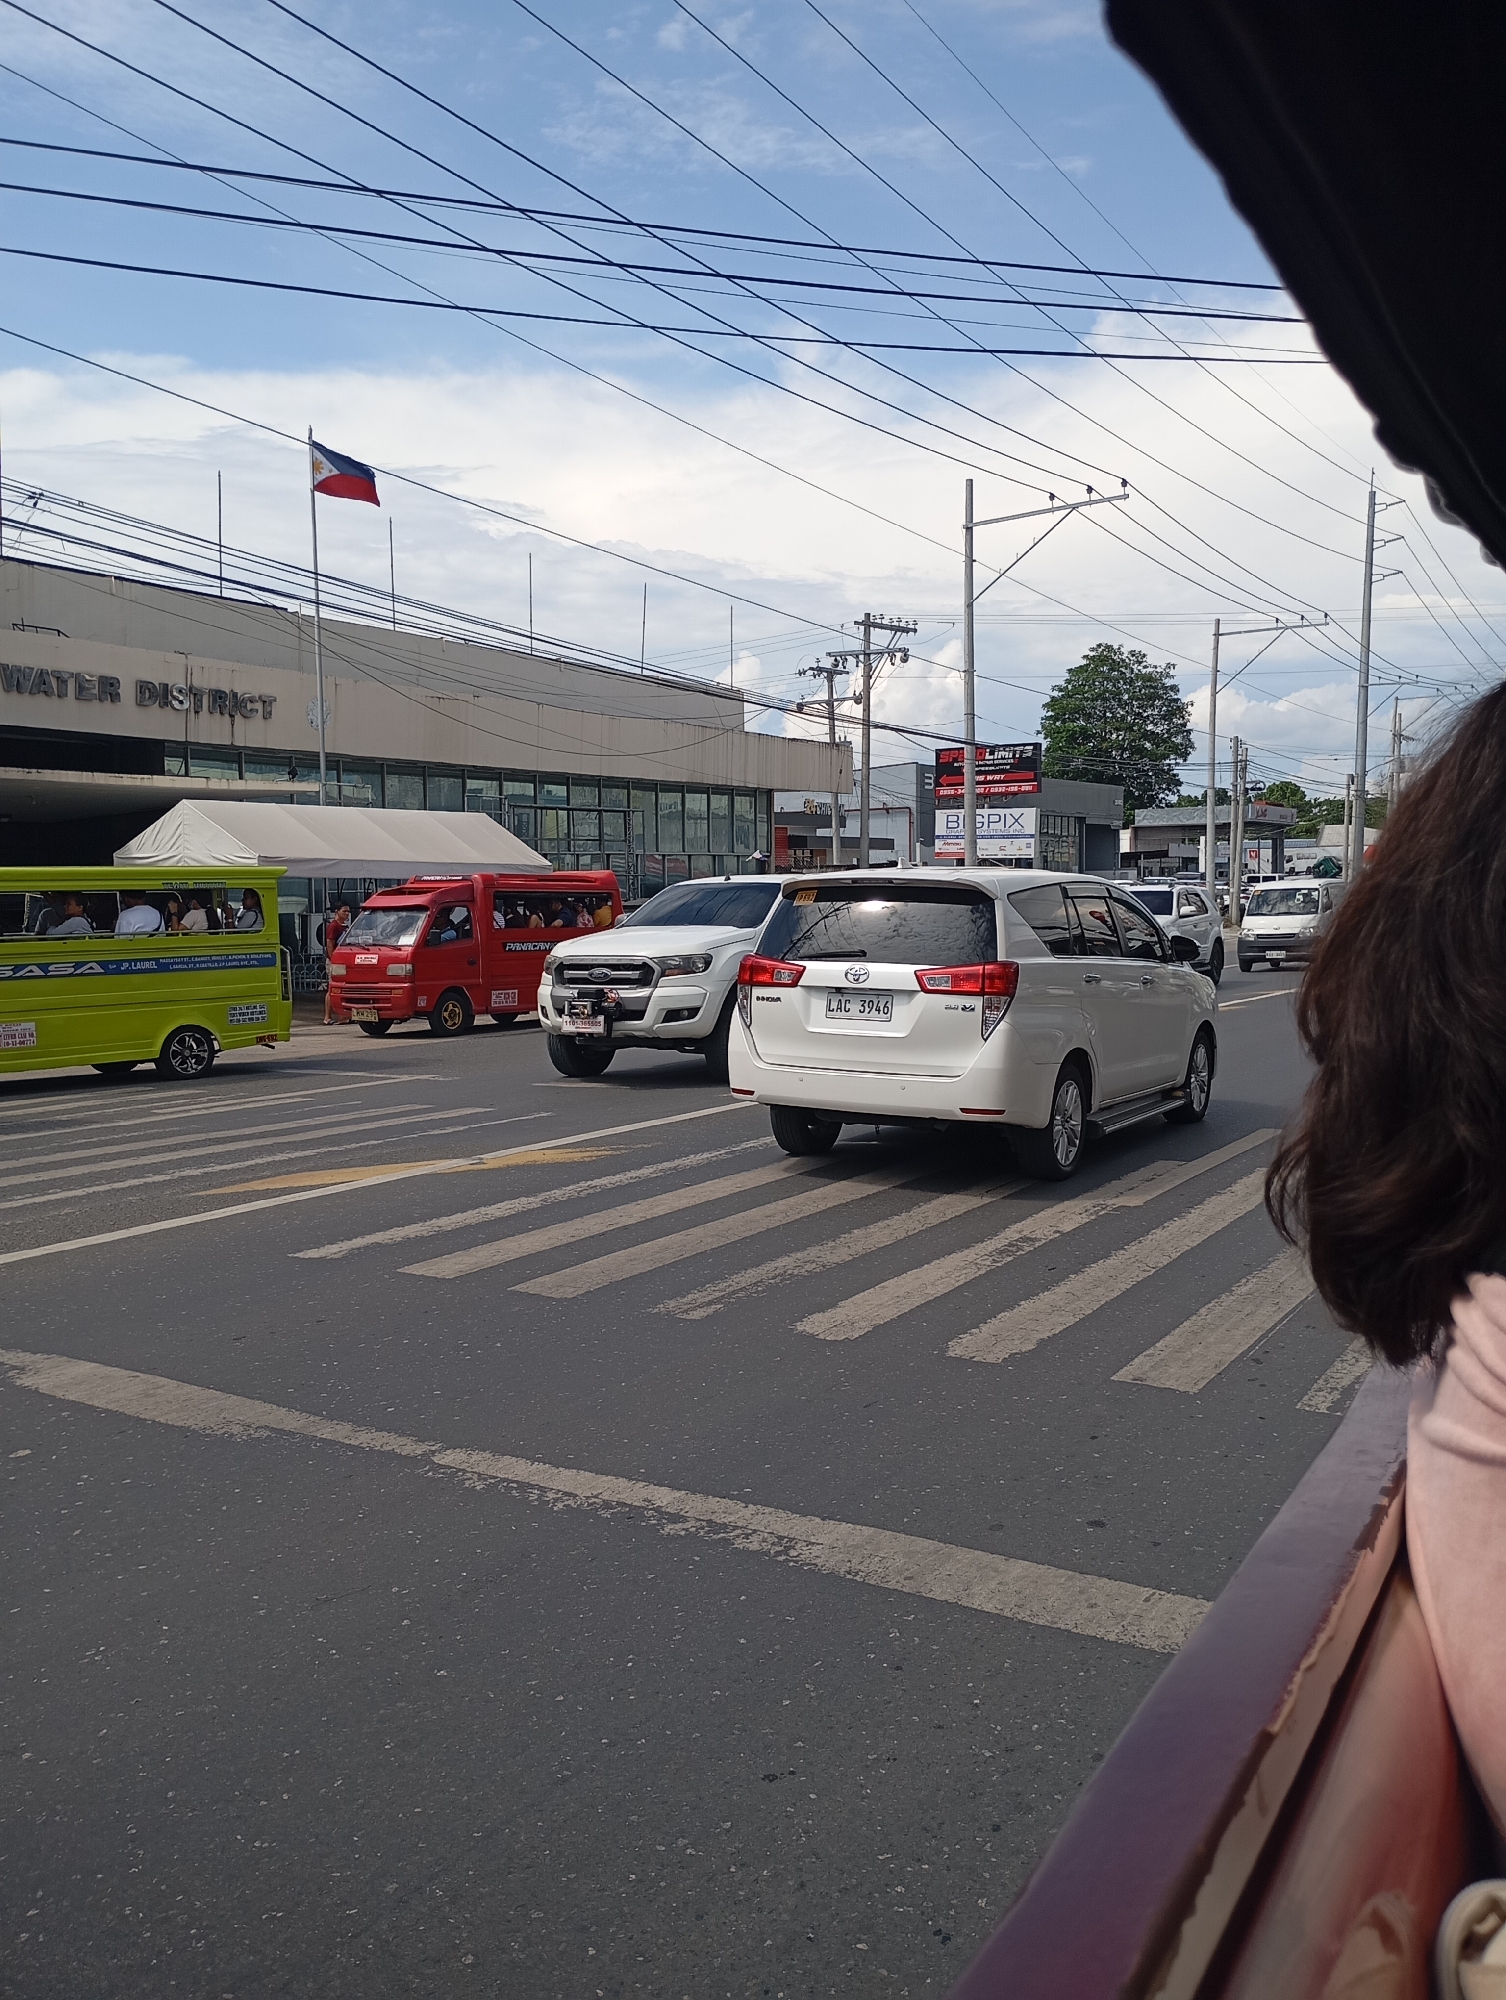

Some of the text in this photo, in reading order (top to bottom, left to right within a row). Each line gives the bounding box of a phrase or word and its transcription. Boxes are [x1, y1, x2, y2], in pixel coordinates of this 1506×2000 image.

[0, 663, 278, 720] WATER DISTRICT
[940, 746, 1033, 762] SPEDLIMITS
[828, 998, 890, 1015] LAC 3946
